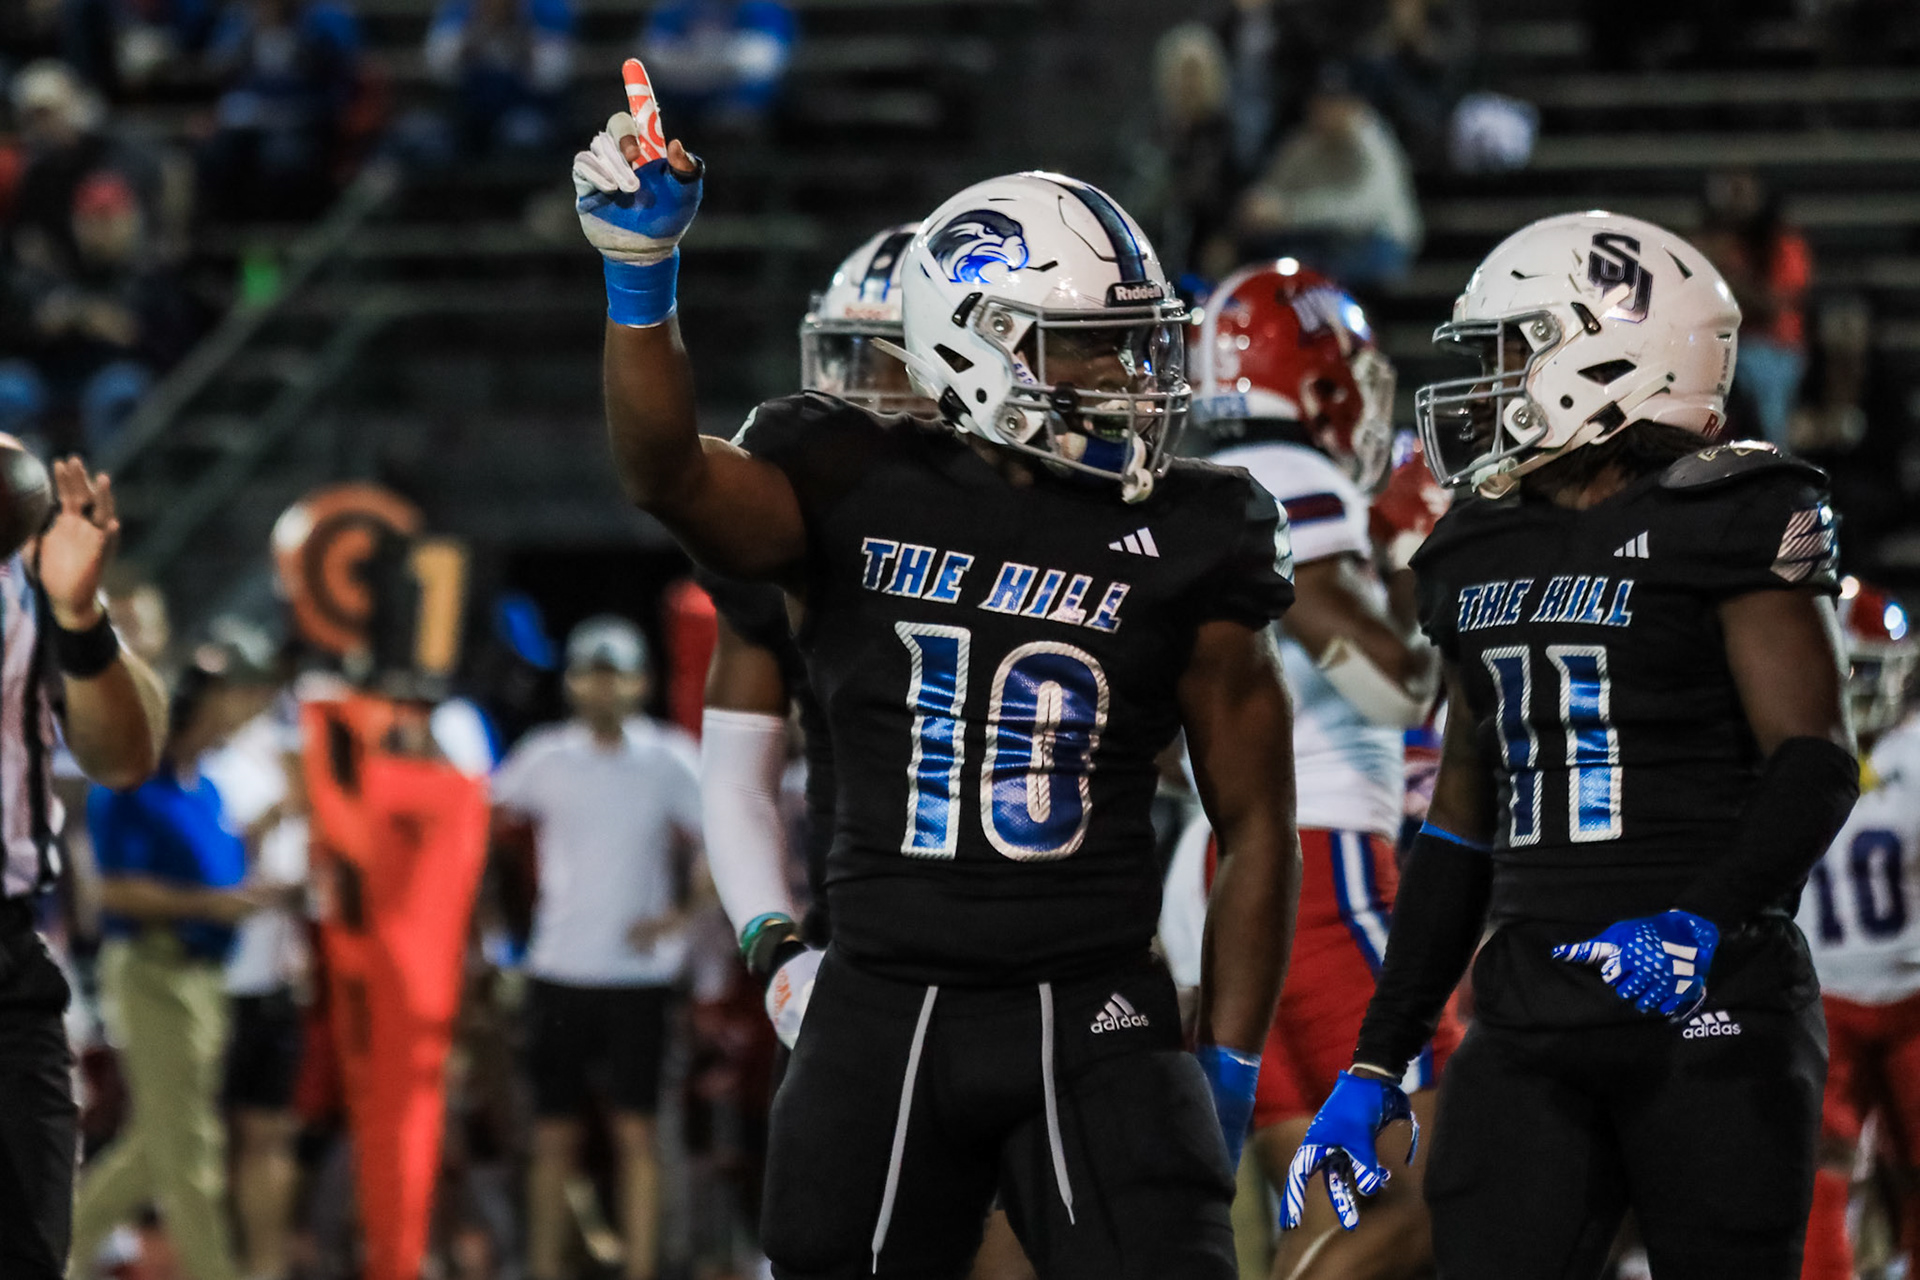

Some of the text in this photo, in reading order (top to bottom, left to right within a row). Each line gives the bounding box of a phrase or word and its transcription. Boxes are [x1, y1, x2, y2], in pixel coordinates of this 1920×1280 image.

[861, 537, 1131, 634] THE HILL
[1458, 575, 1635, 632] THE HILL
[894, 621, 1110, 863] 10
[1481, 644, 1623, 848] 11
[1809, 828, 1906, 945] 10
[1090, 1014, 1149, 1034] adidas
[1682, 1021, 1742, 1039] adidas
